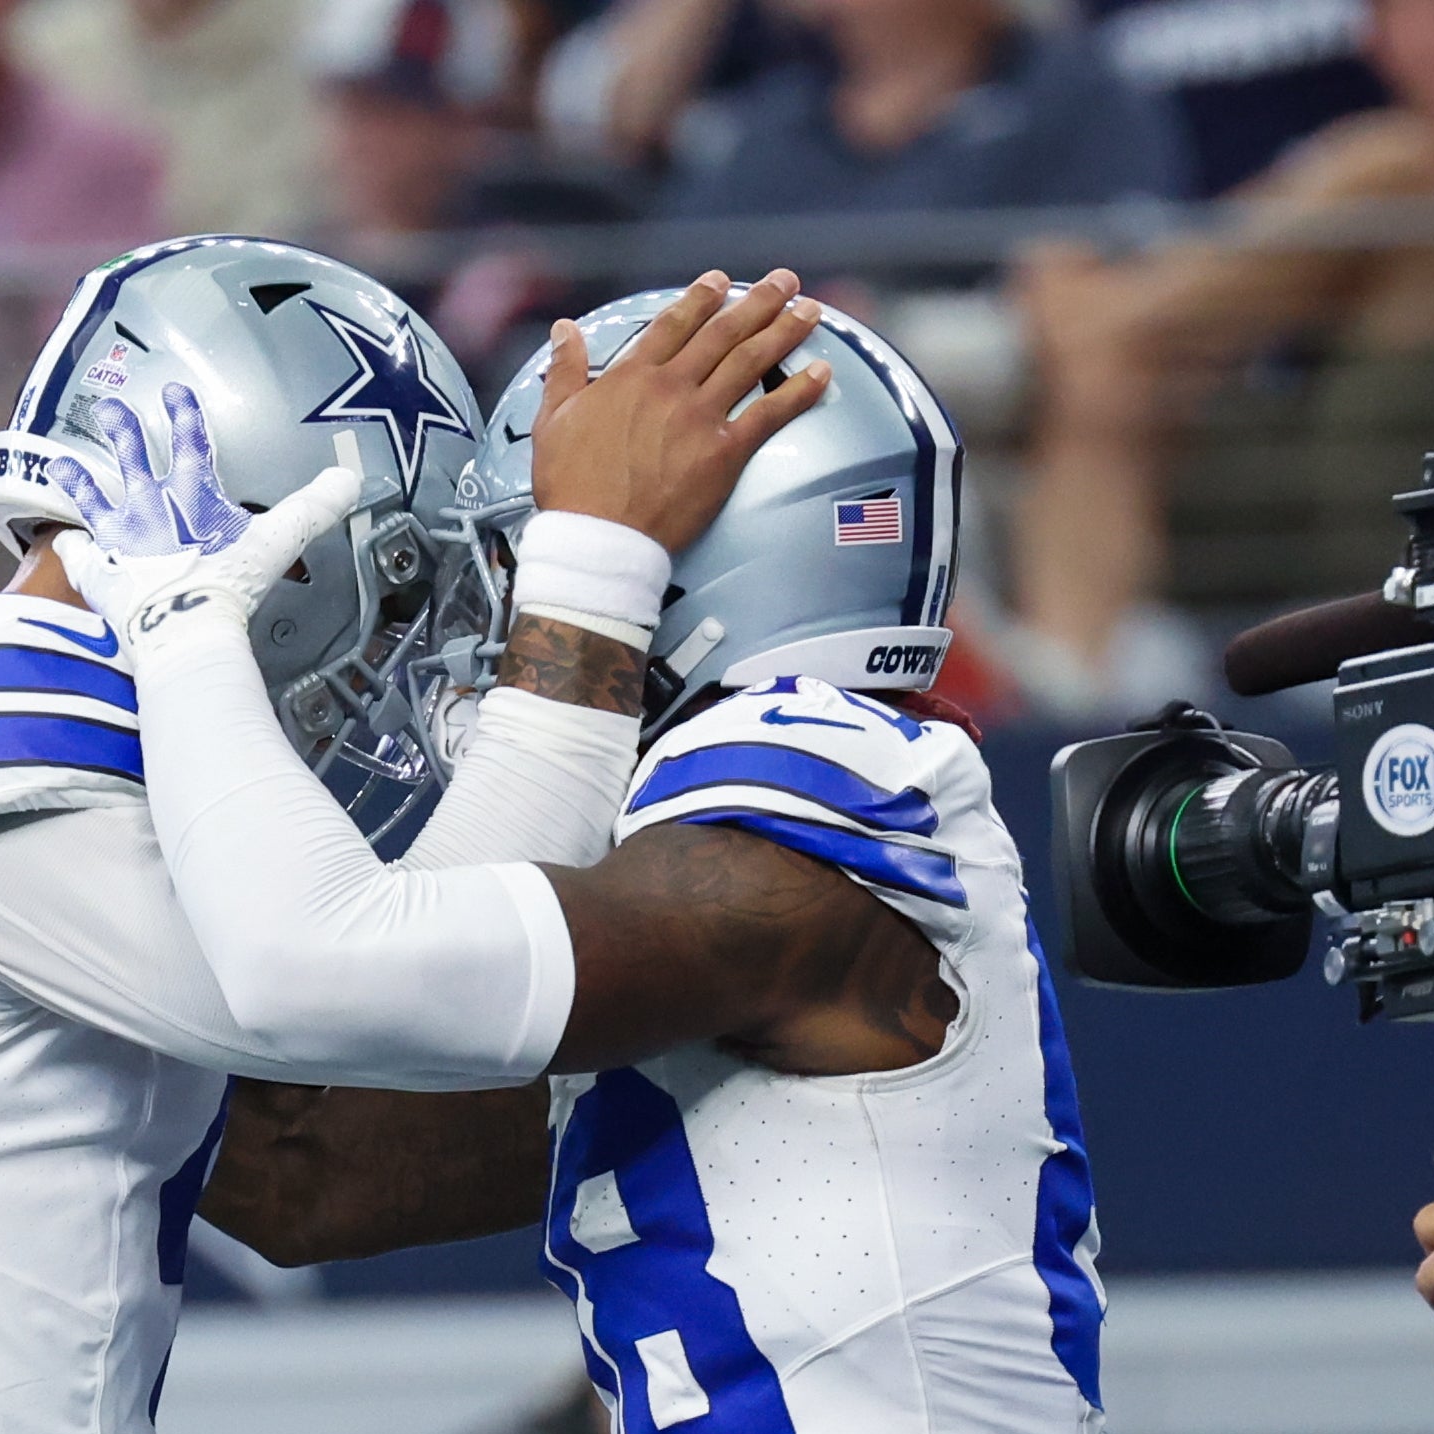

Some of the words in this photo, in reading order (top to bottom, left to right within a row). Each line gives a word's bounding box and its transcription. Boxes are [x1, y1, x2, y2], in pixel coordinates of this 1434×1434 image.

[87, 367, 128, 387] CATCH
[1342, 699, 1384, 719] SONY
[1388, 755, 1430, 792] FOX
[1388, 793, 1433, 808] SPORTS
